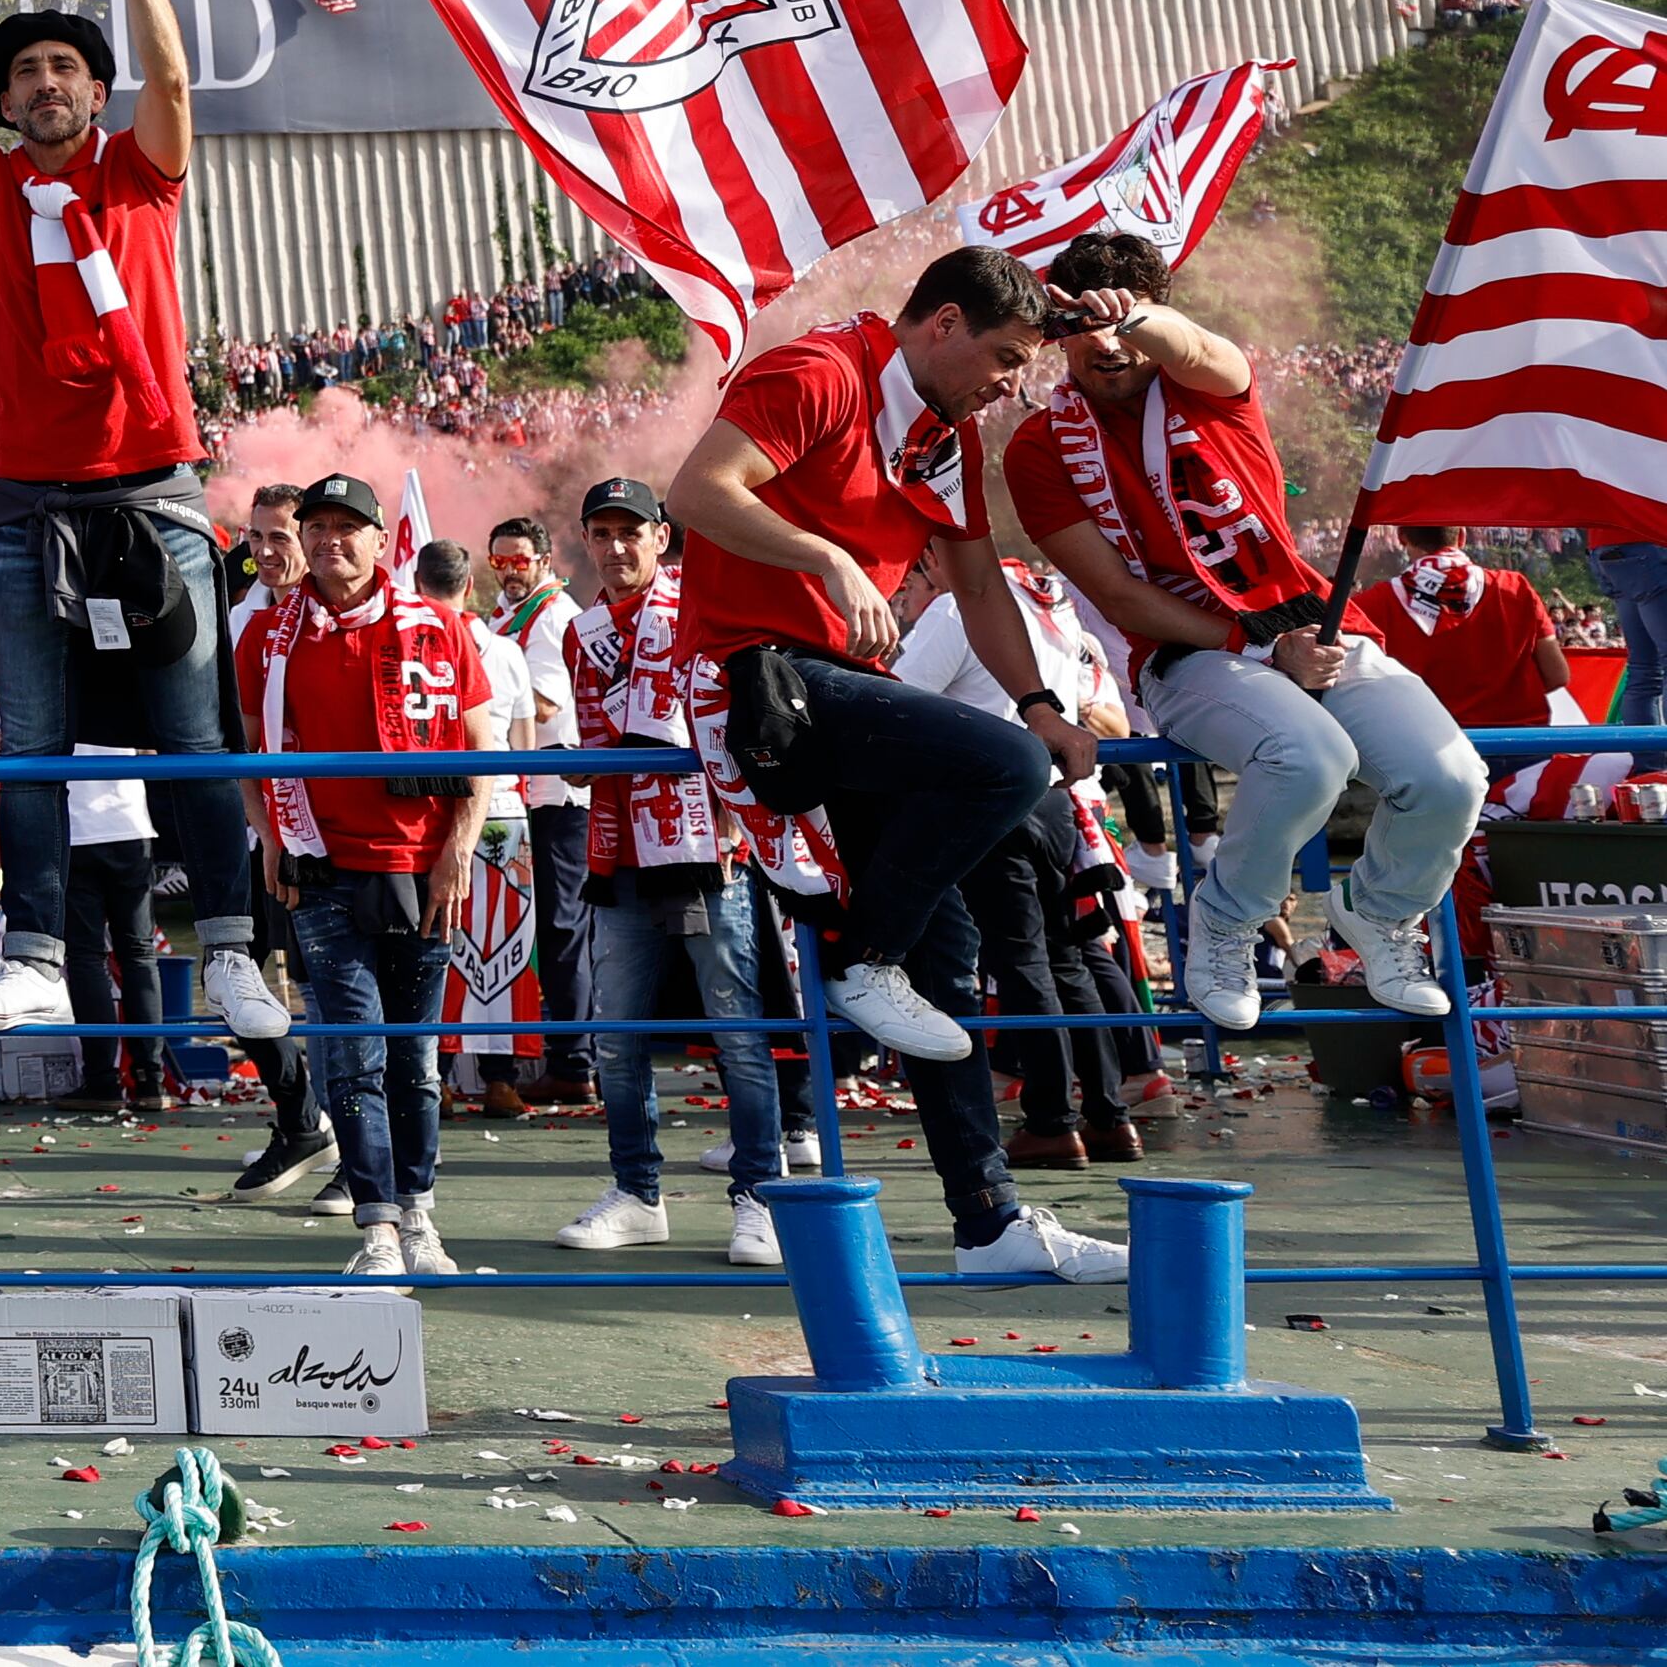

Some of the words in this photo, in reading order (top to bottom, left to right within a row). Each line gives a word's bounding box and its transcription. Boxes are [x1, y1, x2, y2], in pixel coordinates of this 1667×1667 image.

[1151, 184, 1183, 243] BILBAO
[379, 643, 400, 697] SEVILLA
[401, 659, 460, 721] 25
[605, 696, 628, 717] EVILLA
[383, 701, 403, 740] 2024
[247, 1304, 295, 1314] L-4023
[40, 1351, 100, 1361] ALZOLA
[268, 1327, 403, 1392] alzola
[218, 1377, 260, 1397] 24u
[220, 1396, 261, 1409] 330ml
[295, 1397, 330, 1415] basque
[331, 1400, 357, 1409] water
